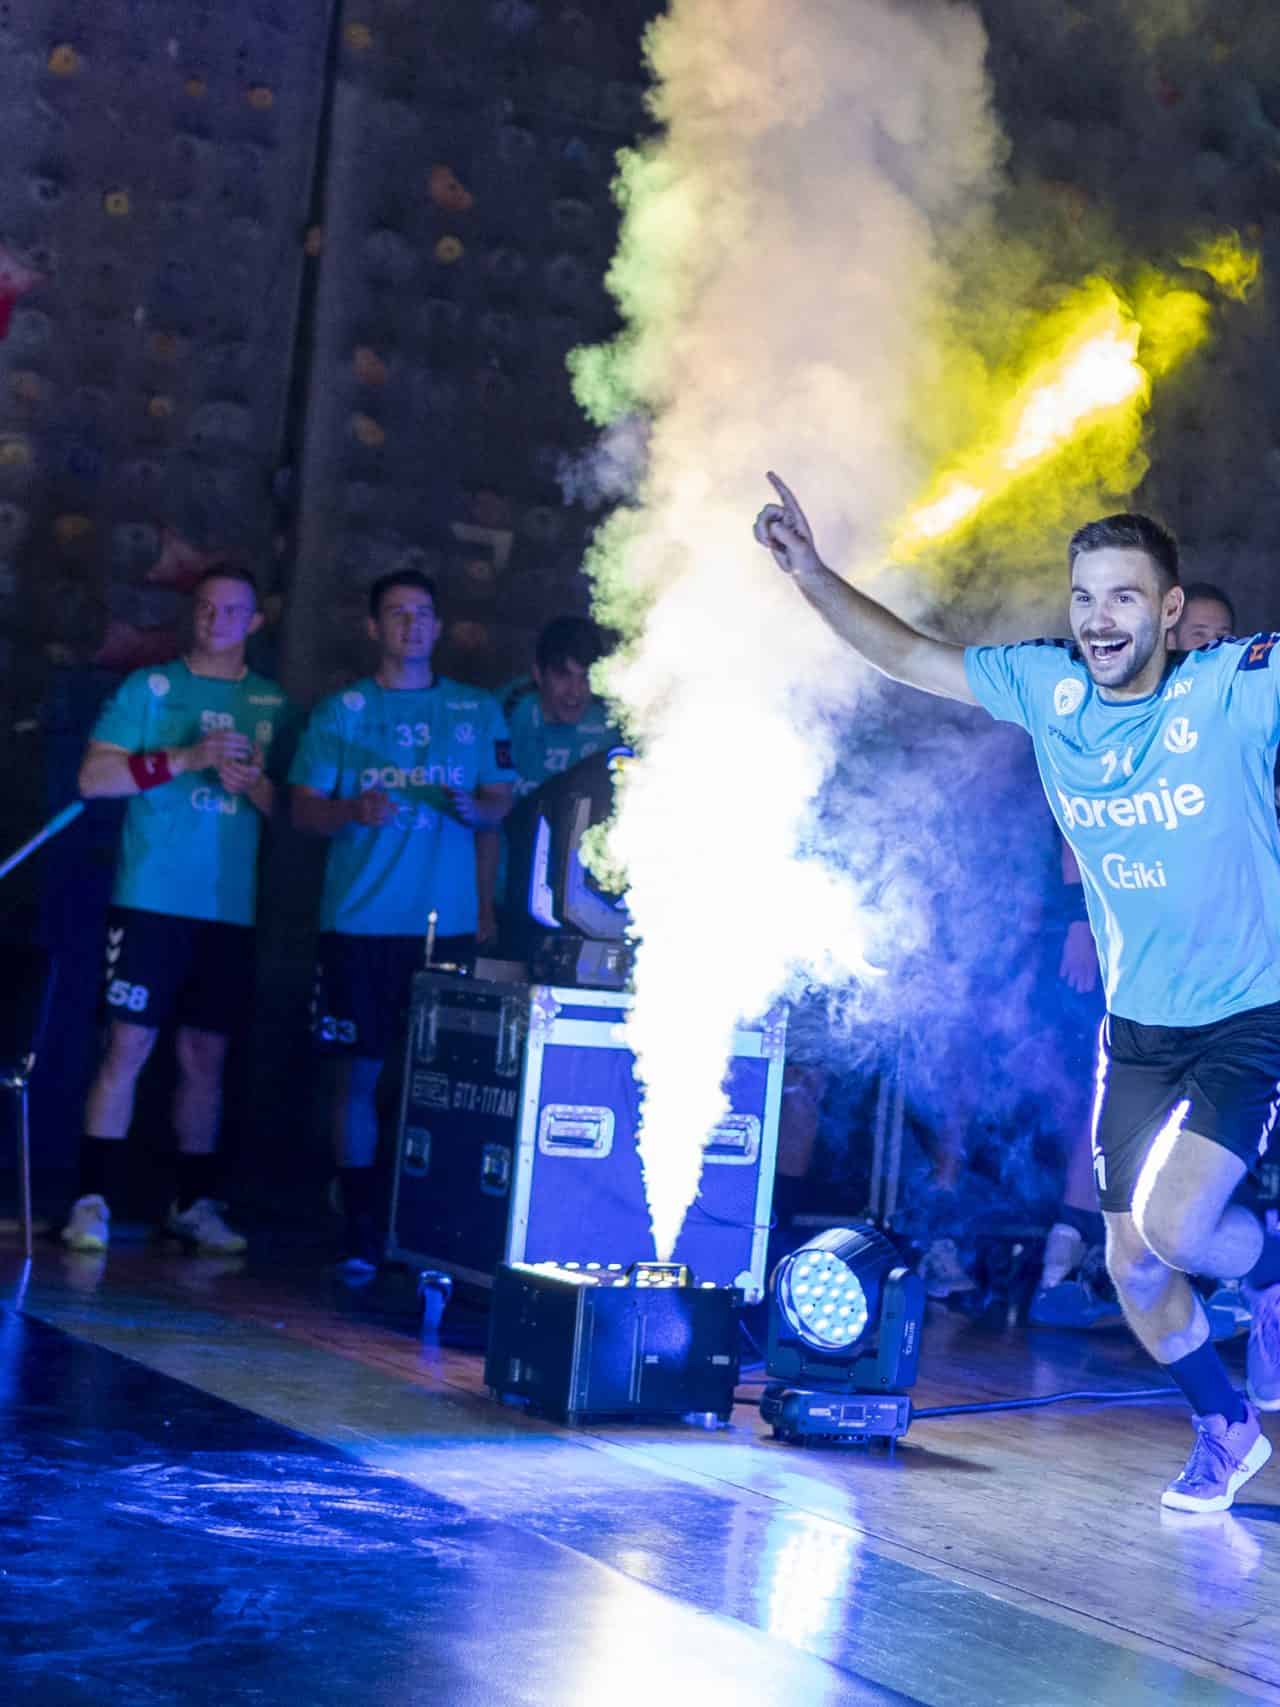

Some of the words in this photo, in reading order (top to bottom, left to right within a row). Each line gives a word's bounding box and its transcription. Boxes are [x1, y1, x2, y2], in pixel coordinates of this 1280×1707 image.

[396, 722, 431, 747] 33
[106, 979, 149, 1011] 58
[321, 1015, 357, 1043] 33
